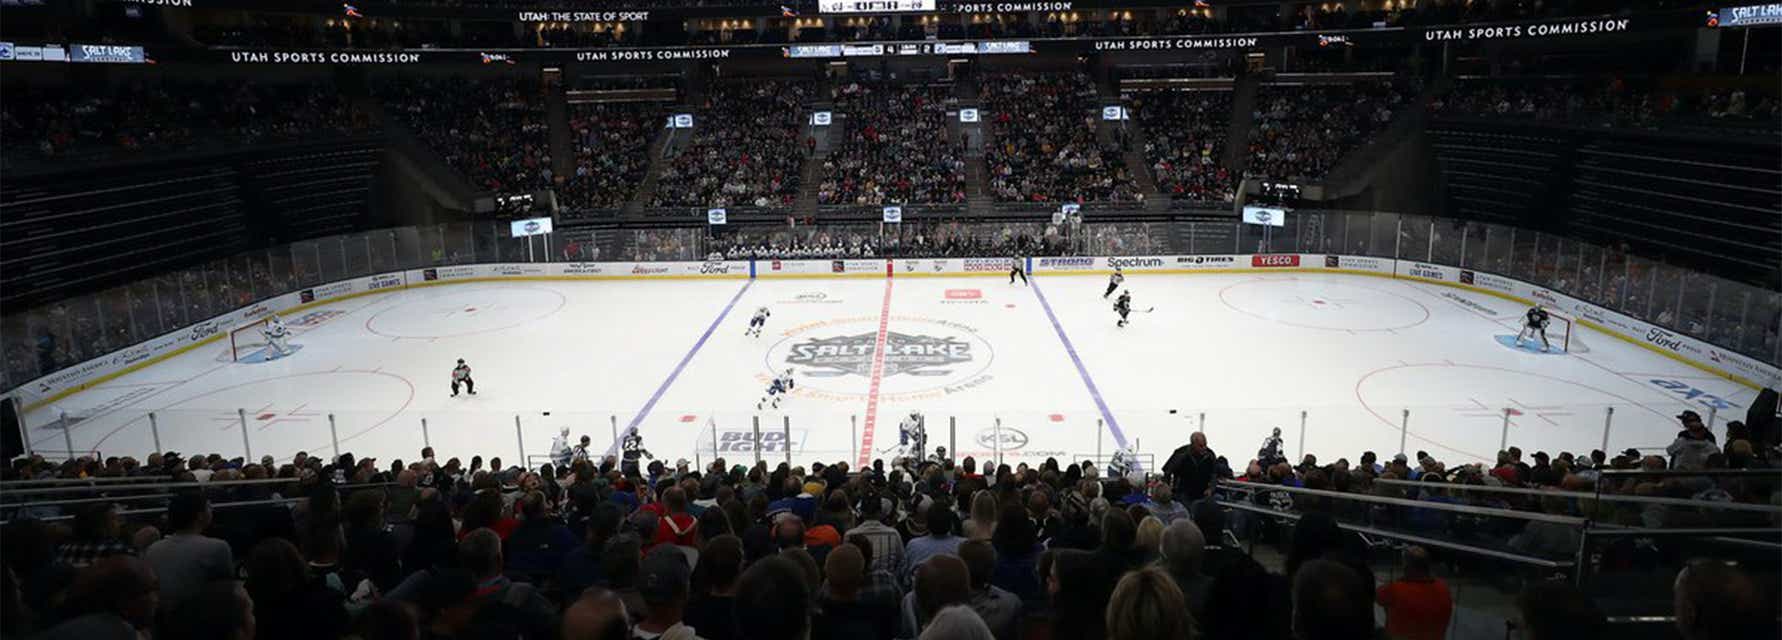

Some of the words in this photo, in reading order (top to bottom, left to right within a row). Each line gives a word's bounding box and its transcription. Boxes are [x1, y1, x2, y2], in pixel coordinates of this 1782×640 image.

[996, 2, 1073, 12] COMMISSION
[551, 12, 571, 21] THE
[574, 12, 601, 21] STATE
[603, 12, 616, 21] OF
[618, 11, 649, 21] SPORT
[1731, 6, 1759, 23] SALT
[1425, 30, 1462, 41] UTAH
[1468, 26, 1521, 39] SPORTS
[1527, 20, 1629, 37] COMMISSION
[1095, 41, 1125, 50] UTAH
[1129, 39, 1172, 50] SPORTS
[1176, 38, 1257, 49] COMMISSION
[81, 45, 106, 59] SALT
[108, 46, 132, 59] LAKE
[232, 52, 269, 62] UTAH
[274, 52, 325, 63] SPORTS
[330, 53, 420, 63] COMMISSION
[577, 52, 607, 61] UTAH
[611, 51, 653, 60] SPORTS
[657, 49, 730, 60] COMMISSION
[1107, 256, 1162, 269] Spectrum
[1261, 256, 1292, 265] YESCO
[700, 262, 729, 274] Ford
[191, 322, 219, 341] Ford
[1646, 327, 1682, 351] Ford
[796, 344, 871, 361] SALT
[887, 343, 970, 359] LAKE
[720, 431, 786, 442] BUD
[719, 441, 798, 452] IGHT
